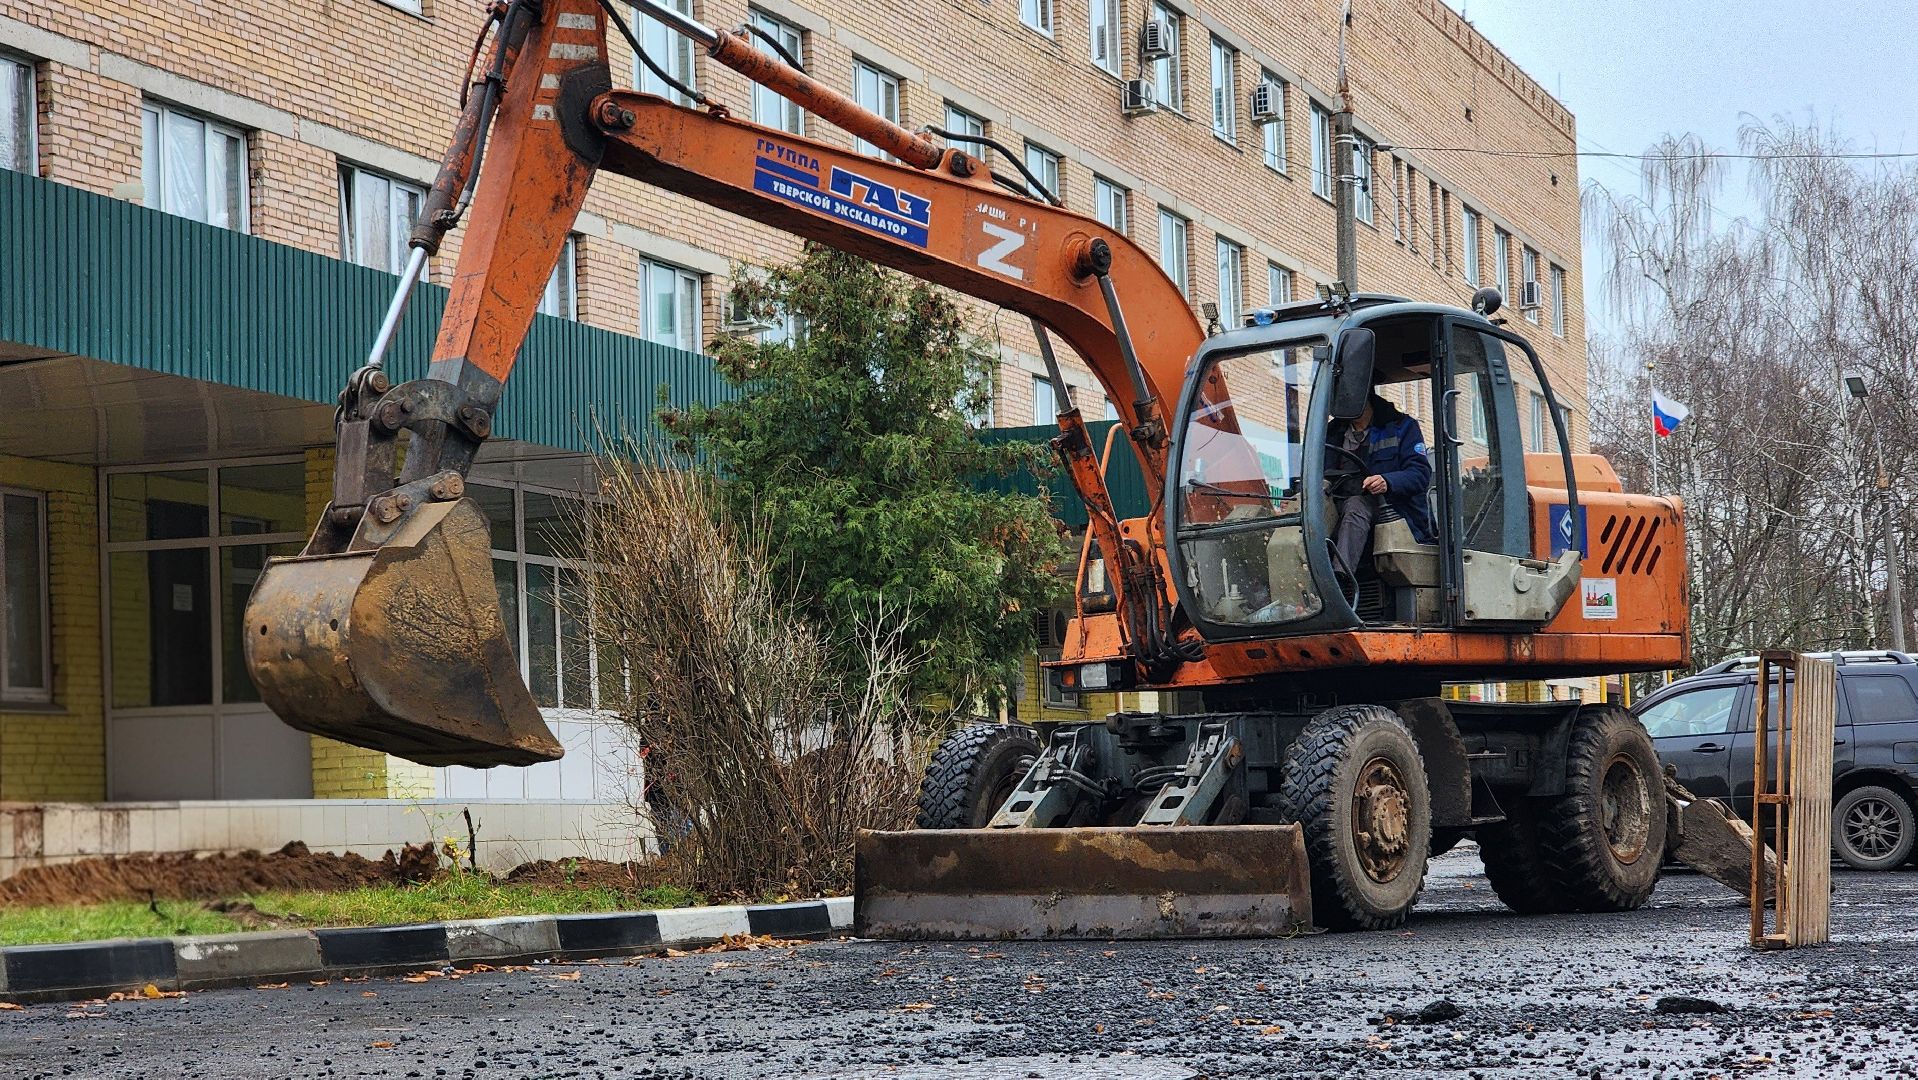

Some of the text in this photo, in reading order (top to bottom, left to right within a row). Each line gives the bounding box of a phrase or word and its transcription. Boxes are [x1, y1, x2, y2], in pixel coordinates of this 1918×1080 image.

[757, 138, 820, 172] ГРУППА
[773, 180, 908, 236] ТВЕРСКОЙ ЭКСКАВАТОР
[829, 165, 931, 227] ГАЗ
[978, 221, 1025, 281] Z
